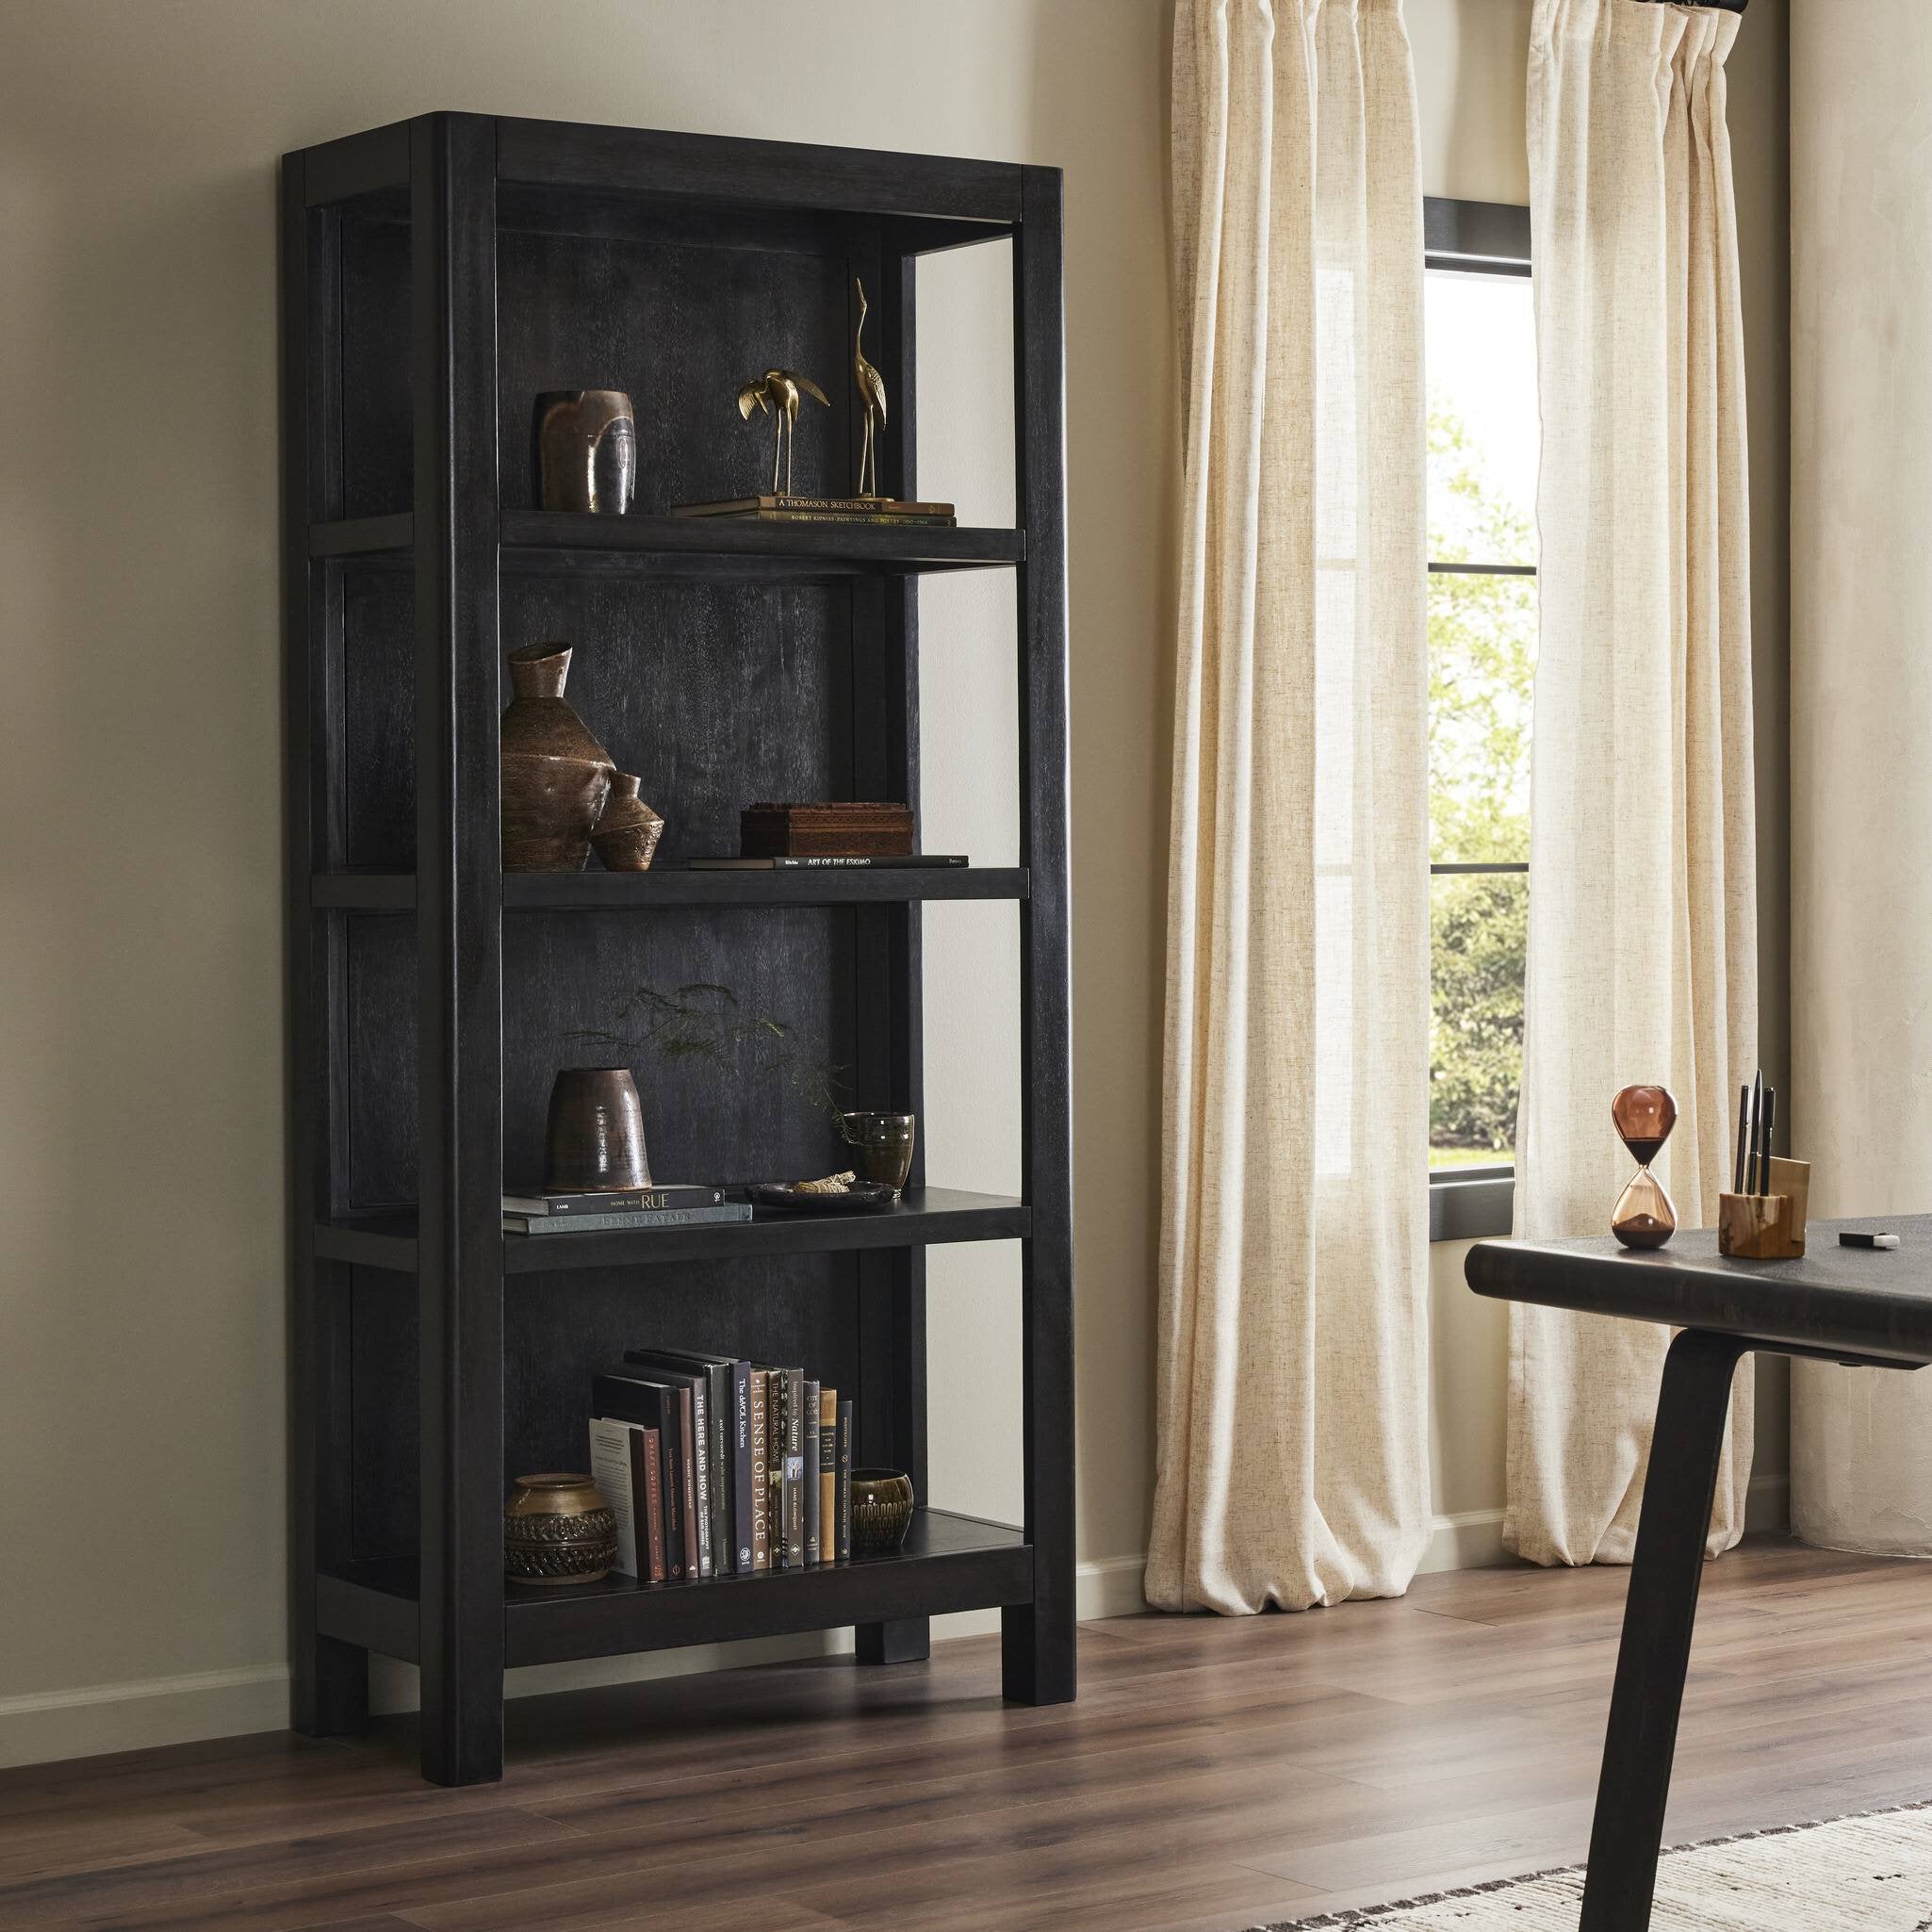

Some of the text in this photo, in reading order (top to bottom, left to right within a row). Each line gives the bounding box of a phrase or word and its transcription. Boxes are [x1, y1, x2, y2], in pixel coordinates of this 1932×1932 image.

[786, 499, 828, 508] THOMASON
[830, 500, 876, 511] SKETCHBOOK
[642, 1193, 670, 1210] RUE
[791, 1408, 798, 1416] by
[753, 1400, 764, 1457] SENSE
[696, 1394, 708, 1501] THE HERE AND NOW
[754, 1462, 765, 1482] OF
[754, 1487, 766, 1542] PLACE
